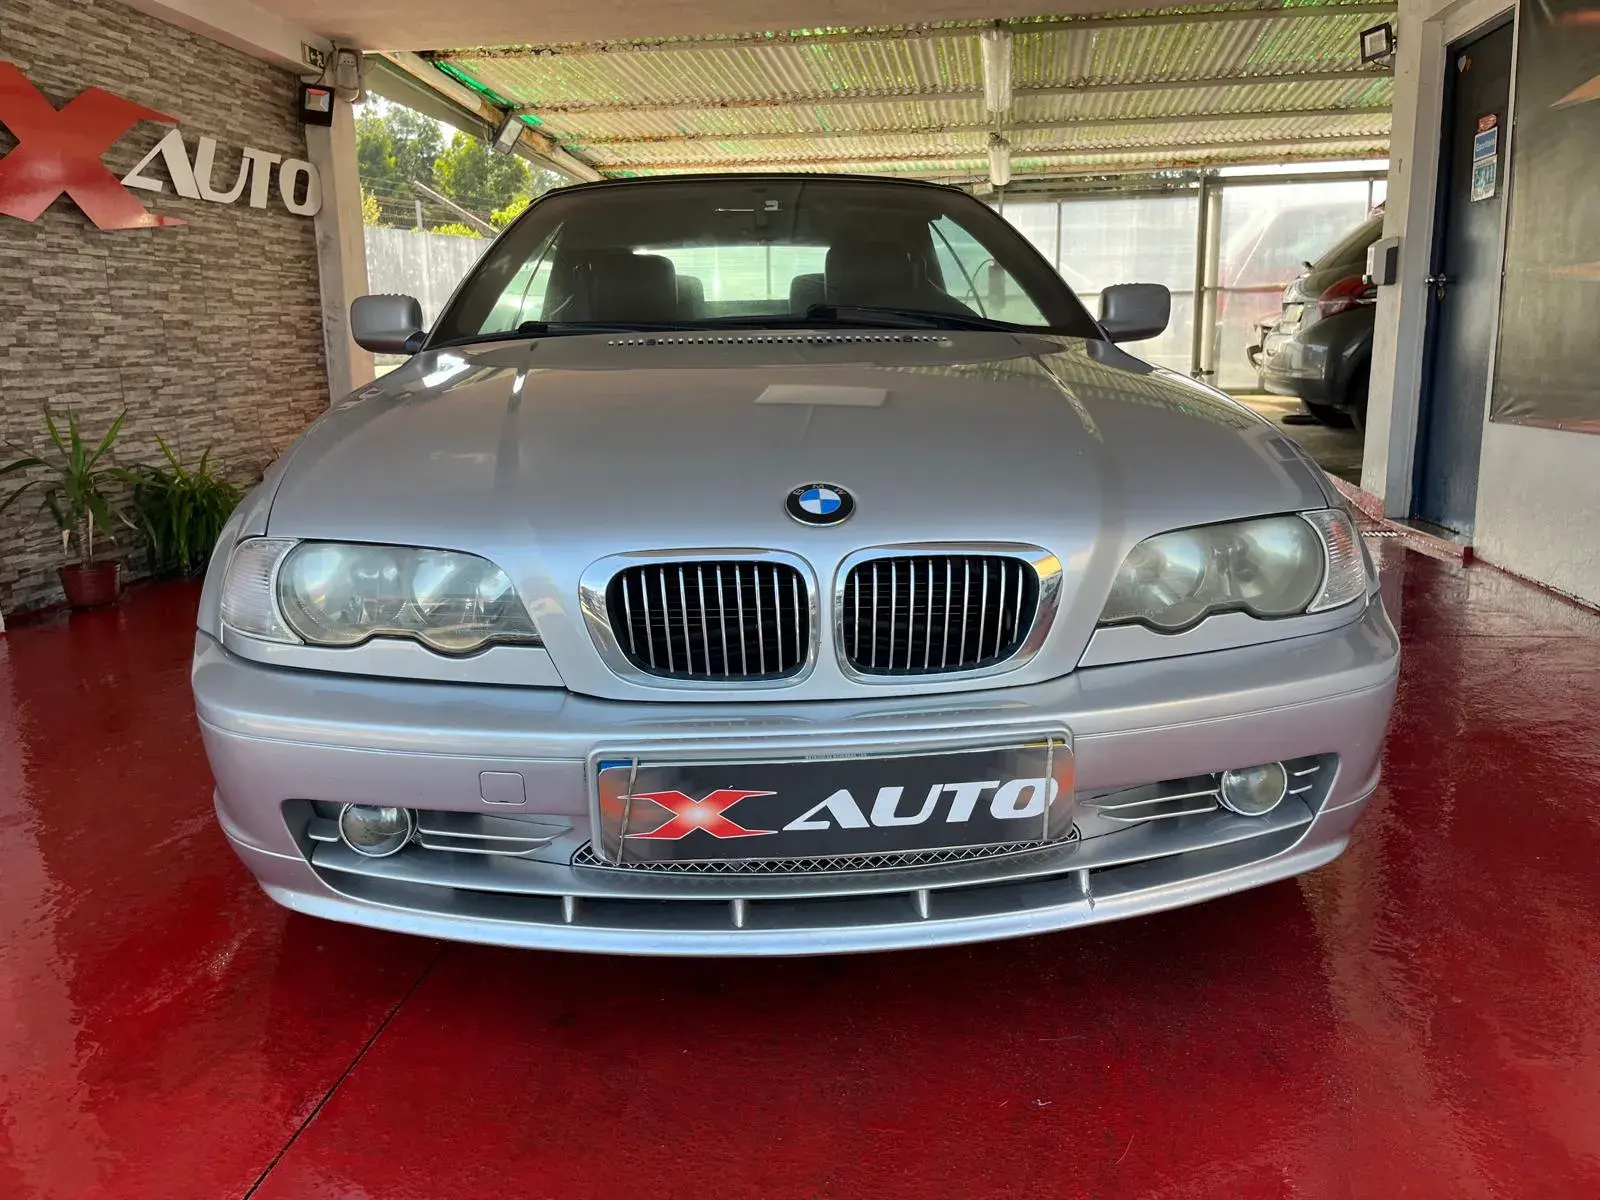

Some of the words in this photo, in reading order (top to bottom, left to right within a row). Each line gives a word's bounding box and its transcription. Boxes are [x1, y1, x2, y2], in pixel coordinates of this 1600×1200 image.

[0, 60, 188, 230] X
[120, 128, 322, 216] AUTO
[792, 484, 847, 495] BMW
[617, 789, 778, 840] X
[782, 777, 1058, 831] AUTO
